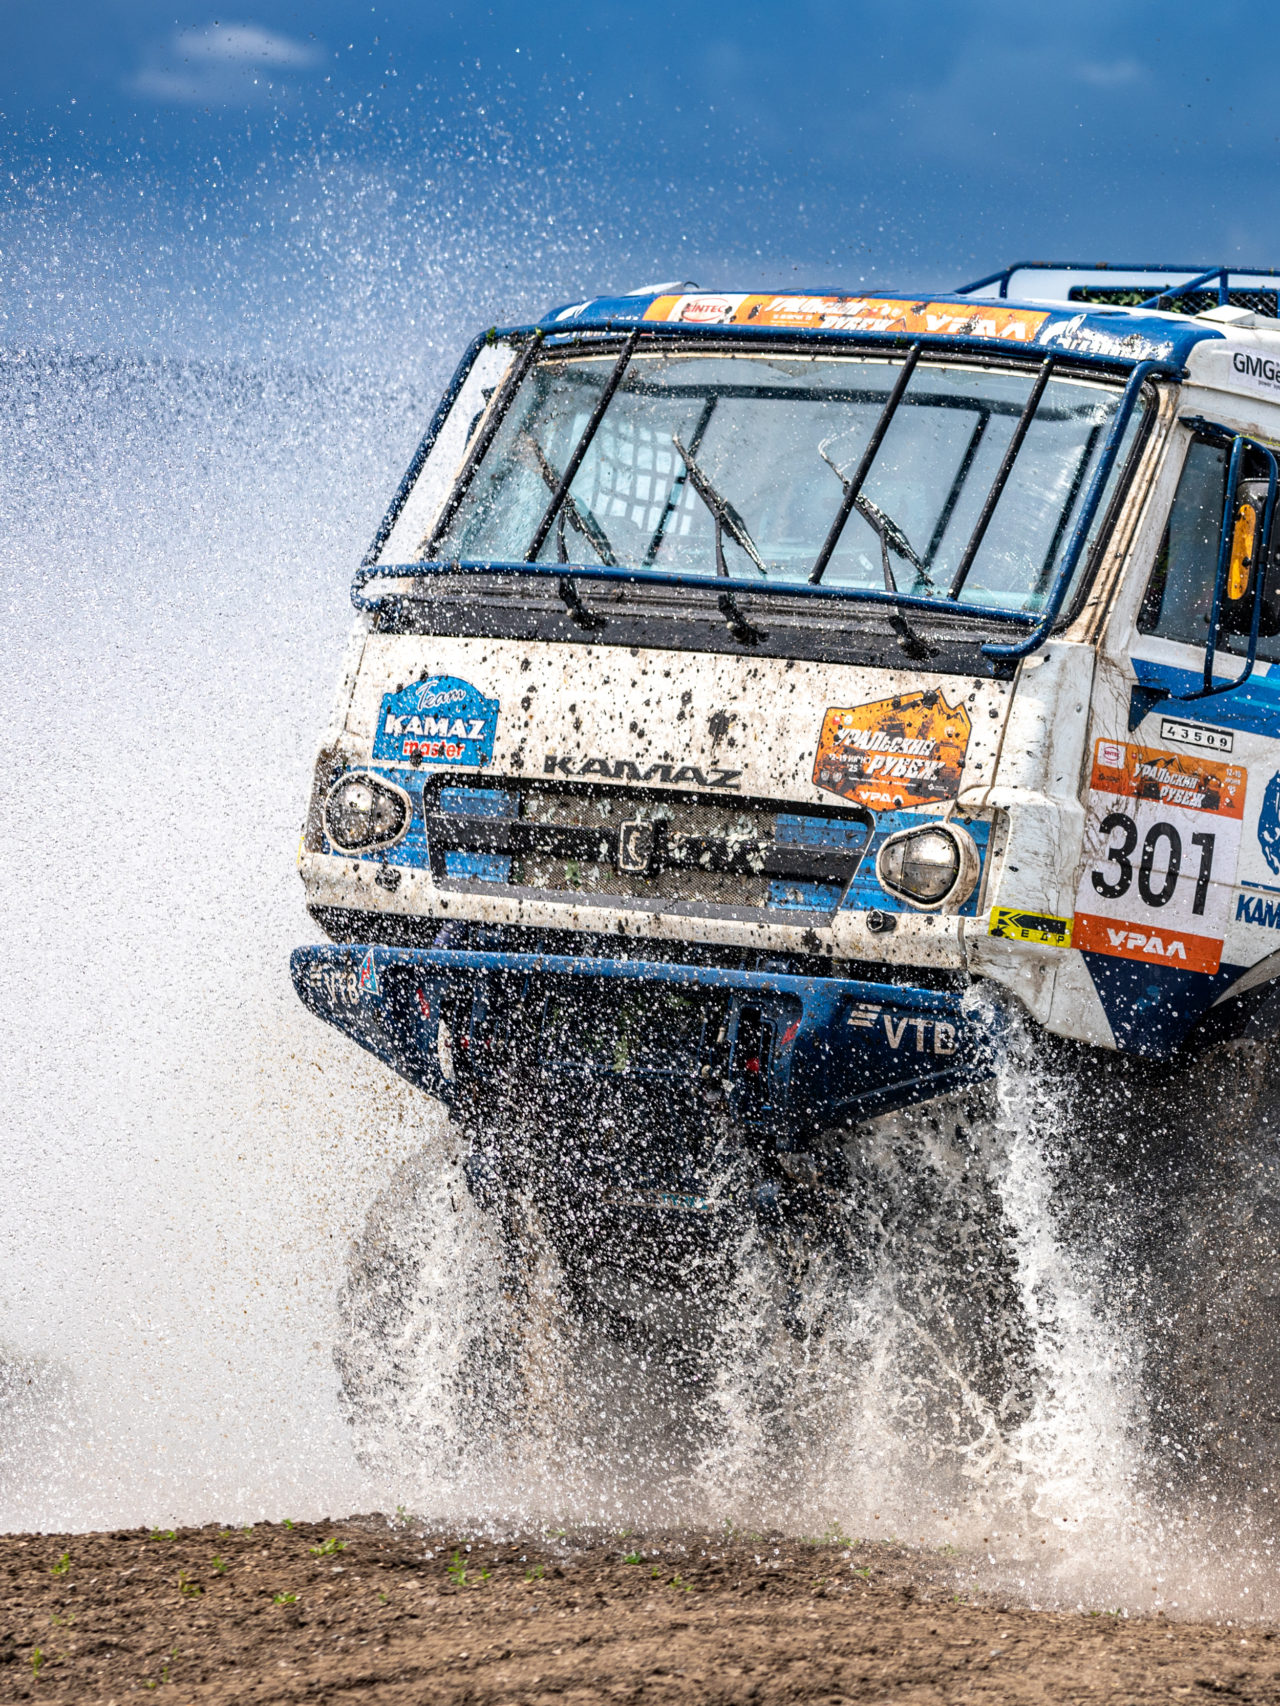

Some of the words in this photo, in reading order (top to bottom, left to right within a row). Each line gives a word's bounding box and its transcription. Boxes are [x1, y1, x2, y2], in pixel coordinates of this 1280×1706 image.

[415, 682, 467, 711] Team
[384, 714, 487, 741] KAMAZ
[834, 727, 938, 757] УРАЛЬСКИЙ
[1165, 726, 1229, 749] 43509
[402, 740, 464, 760] master
[542, 755, 745, 791] KAMAZ
[865, 754, 946, 781] РУБЕЖ
[1158, 784, 1206, 809] РУБЕЖ
[1091, 812, 1216, 917] 301
[1105, 927, 1188, 960] УРАЛ
[883, 1014, 957, 1056] VTB
